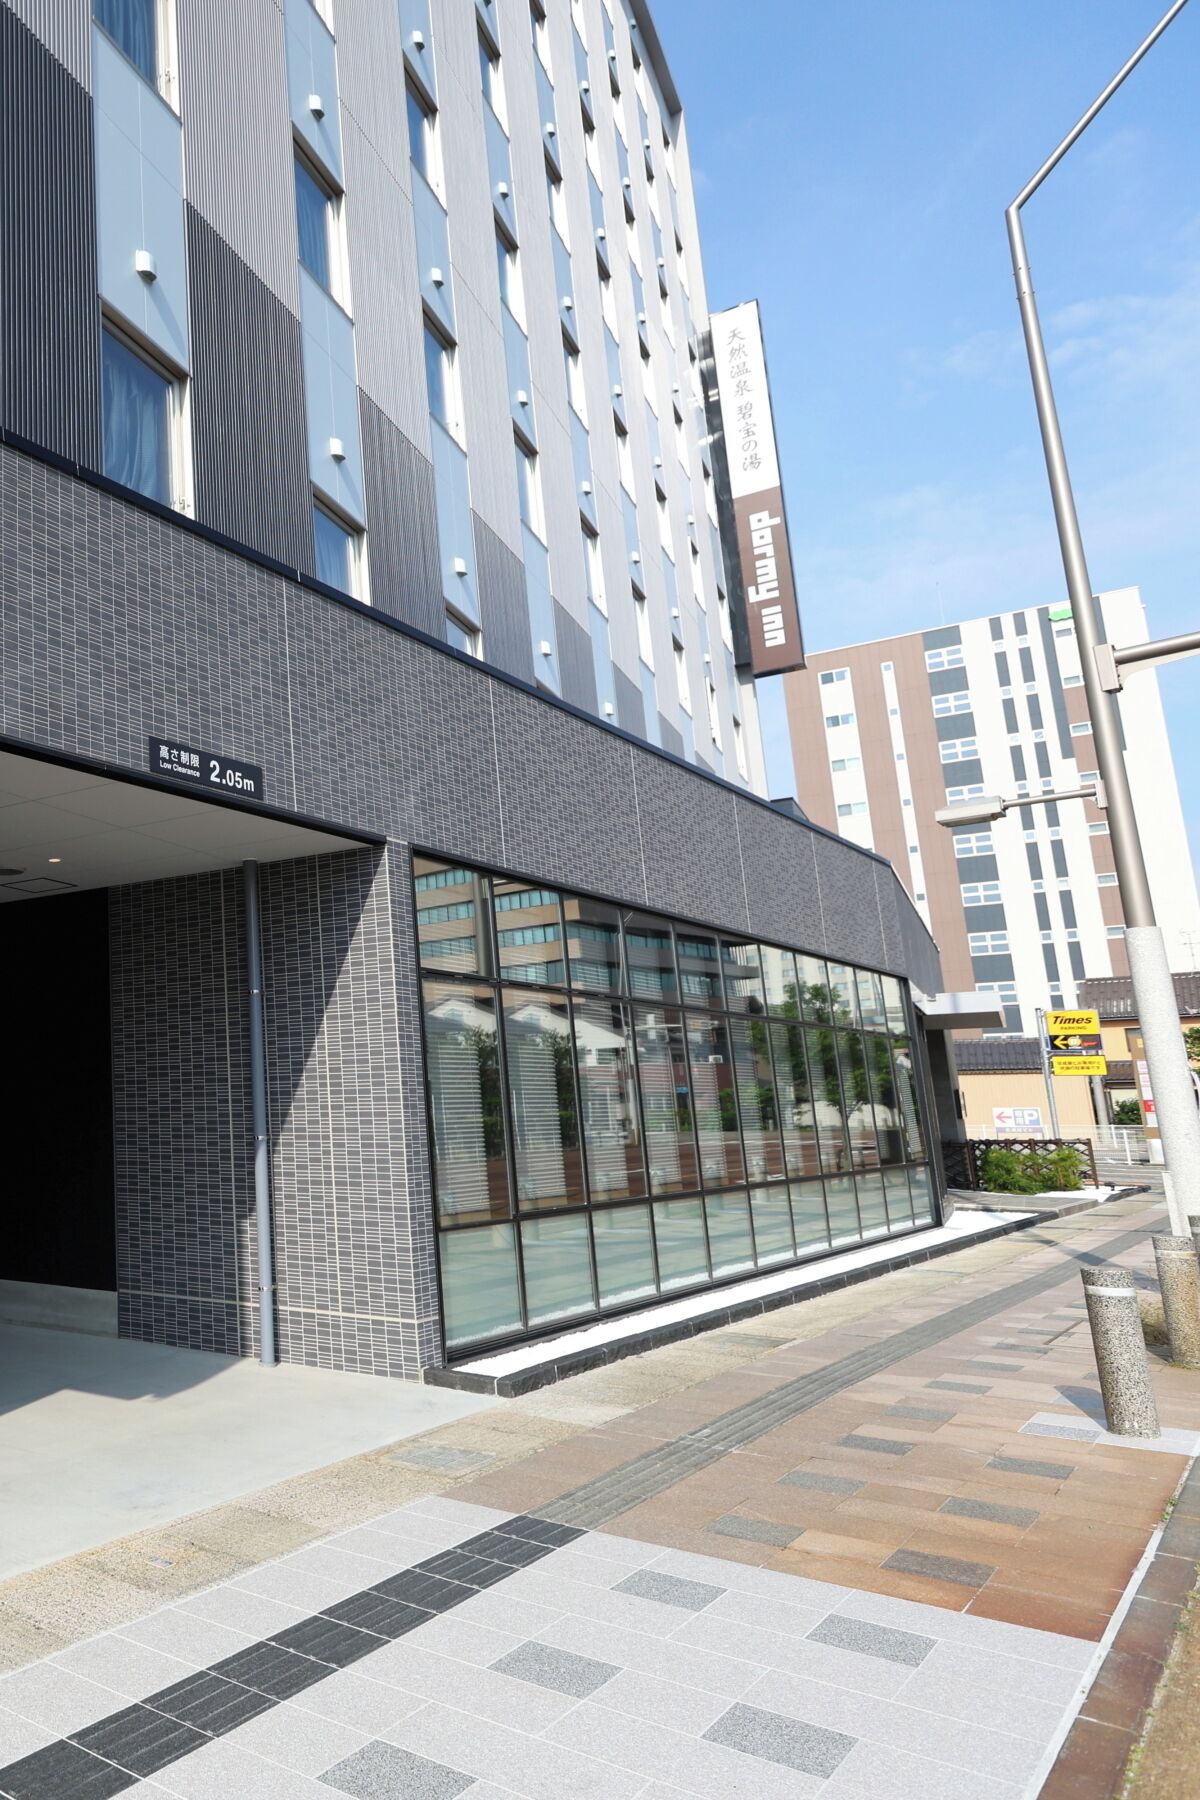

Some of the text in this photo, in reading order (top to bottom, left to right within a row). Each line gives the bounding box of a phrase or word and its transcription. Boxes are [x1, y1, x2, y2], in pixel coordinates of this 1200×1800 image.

[726, 327, 763, 472] 天然温泉 碧宝の湯
[747, 510, 786, 648] dormy inn
[159, 744, 200, 768] 高さ制限
[159, 760, 201, 778] Low Clearance
[209, 760, 255, 792] 2.05m
[1053, 1015, 1093, 1025] Times
